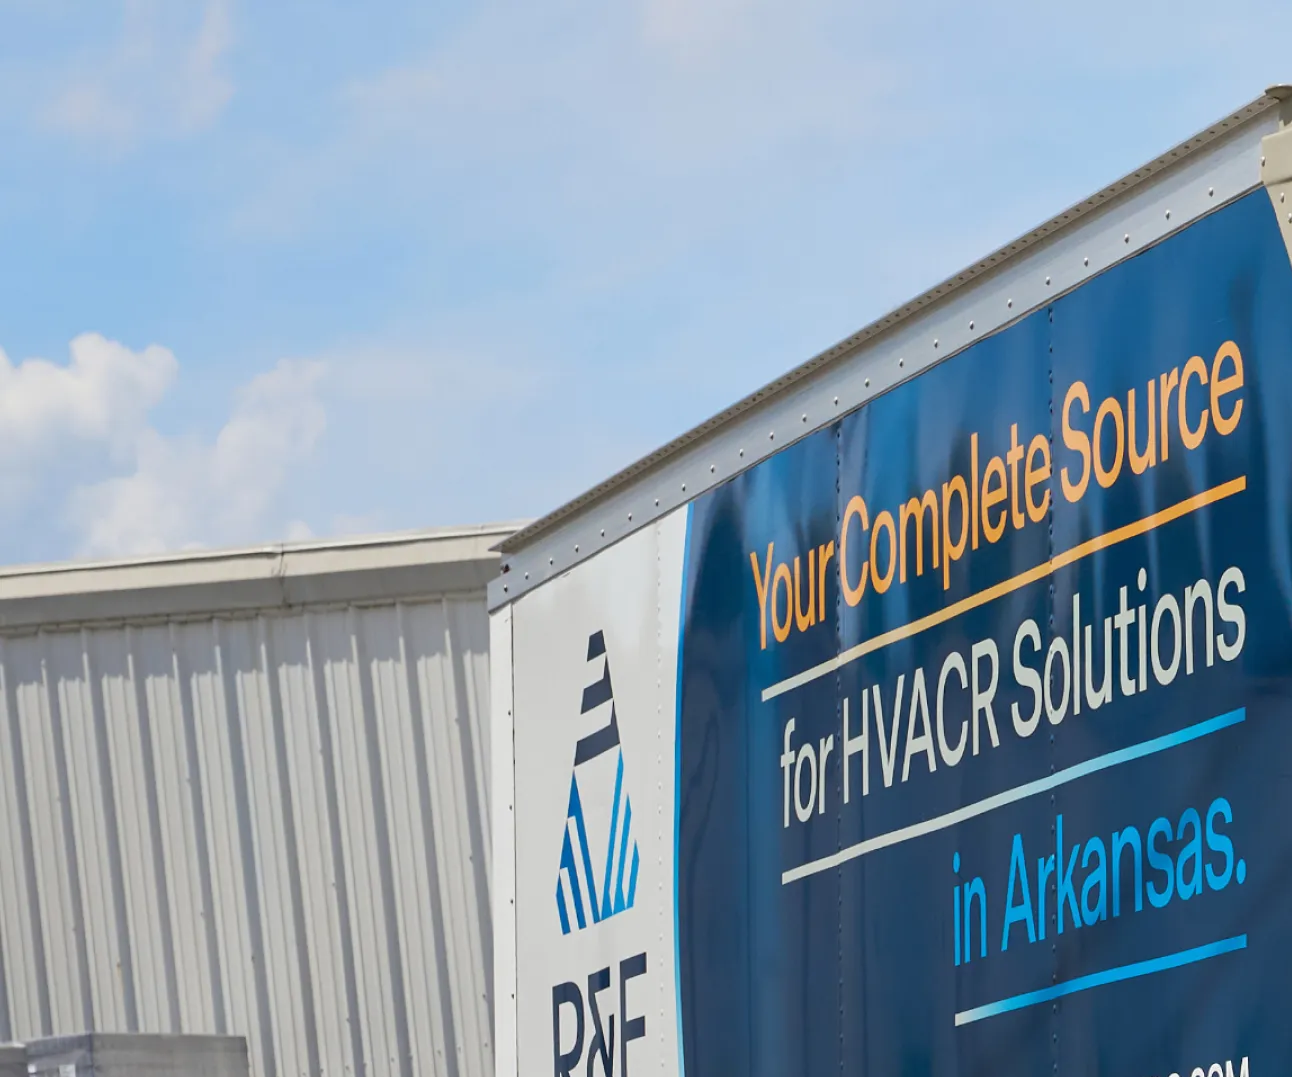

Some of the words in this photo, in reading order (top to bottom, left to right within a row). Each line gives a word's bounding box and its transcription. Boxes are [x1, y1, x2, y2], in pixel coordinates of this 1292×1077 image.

[750, 540, 834, 651] Your
[839, 422, 1051, 608] Complete
[1060, 340, 1245, 503] Source
[780, 717, 834, 829] for
[843, 637, 1000, 805] HVACR
[1011, 566, 1247, 738] Solutions
[953, 851, 988, 967] in
[1001, 796, 1247, 952] Arkansas.
